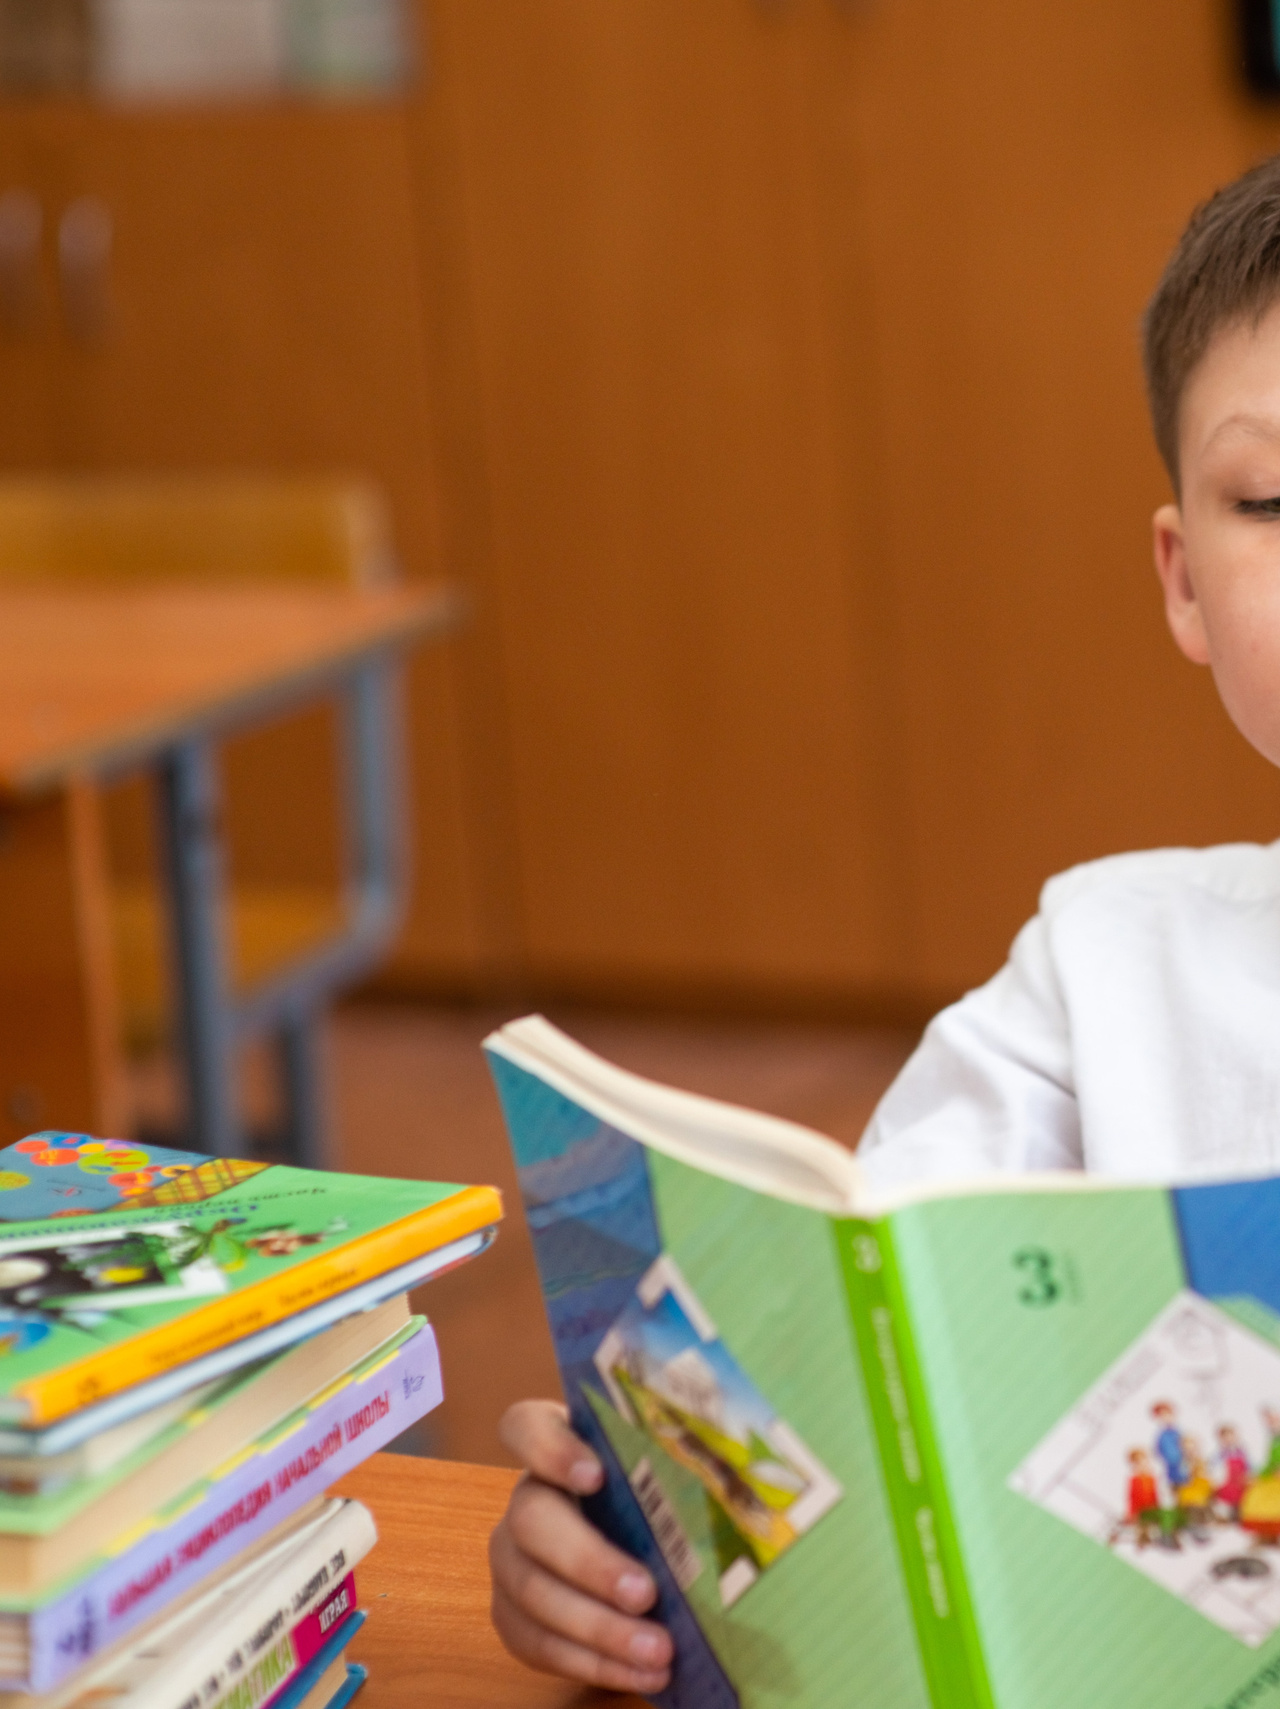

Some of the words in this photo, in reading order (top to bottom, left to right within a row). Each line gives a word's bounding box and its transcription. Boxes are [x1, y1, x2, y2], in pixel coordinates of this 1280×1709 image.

[1012, 1245, 1061, 1308] 3
[273, 1421, 344, 1500] НАЧАЛЬНОЙ
[344, 1390, 391, 1442] ШКОЛЫ
[318, 1588, 349, 1635] ИГРАЯ
